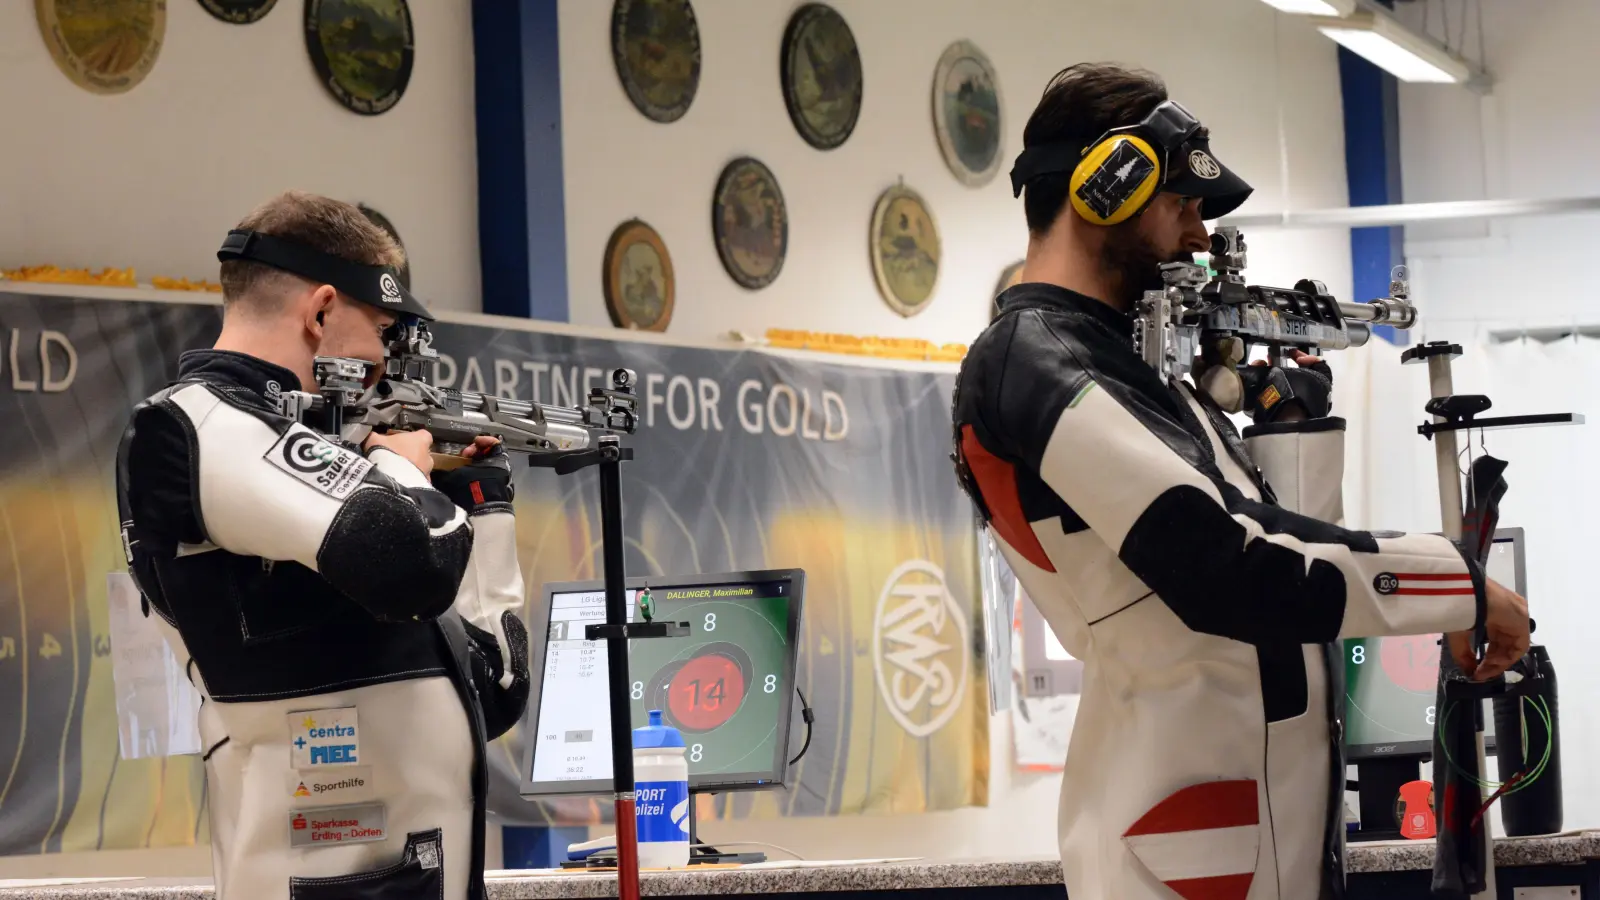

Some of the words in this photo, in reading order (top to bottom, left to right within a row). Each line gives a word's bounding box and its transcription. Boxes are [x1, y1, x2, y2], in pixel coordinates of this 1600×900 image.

[1190, 152, 1219, 177] RWS
[0, 327, 78, 392] LD
[432, 353, 616, 410] PARTNE
[645, 373, 724, 432] FOR
[736, 379, 849, 441] GOLD
[316, 452, 351, 488] Sauer
[336, 460, 369, 494] Germany
[666, 589, 711, 600] DALLINGER,
[712, 587, 753, 597] Maximilian
[778, 585, 783, 594] 1
[553, 622, 563, 639] 1
[703, 612, 717, 632] 8
[1351, 645, 1366, 665] 8
[631, 681, 644, 700] 8
[689, 677, 726, 706] 14
[763, 674, 777, 694] 8
[309, 725, 355, 738] centra
[310, 744, 357, 764] MEC
[690, 743, 703, 763] 8
[1373, 745, 1397, 753] acer
[313, 778, 365, 793] Sporthilfe
[635, 788, 667, 801] PORT
[635, 803, 665, 816] olizei
[311, 819, 359, 830] Sparkasse
[311, 831, 342, 841] Erding
[351, 828, 382, 838] Dorfen
